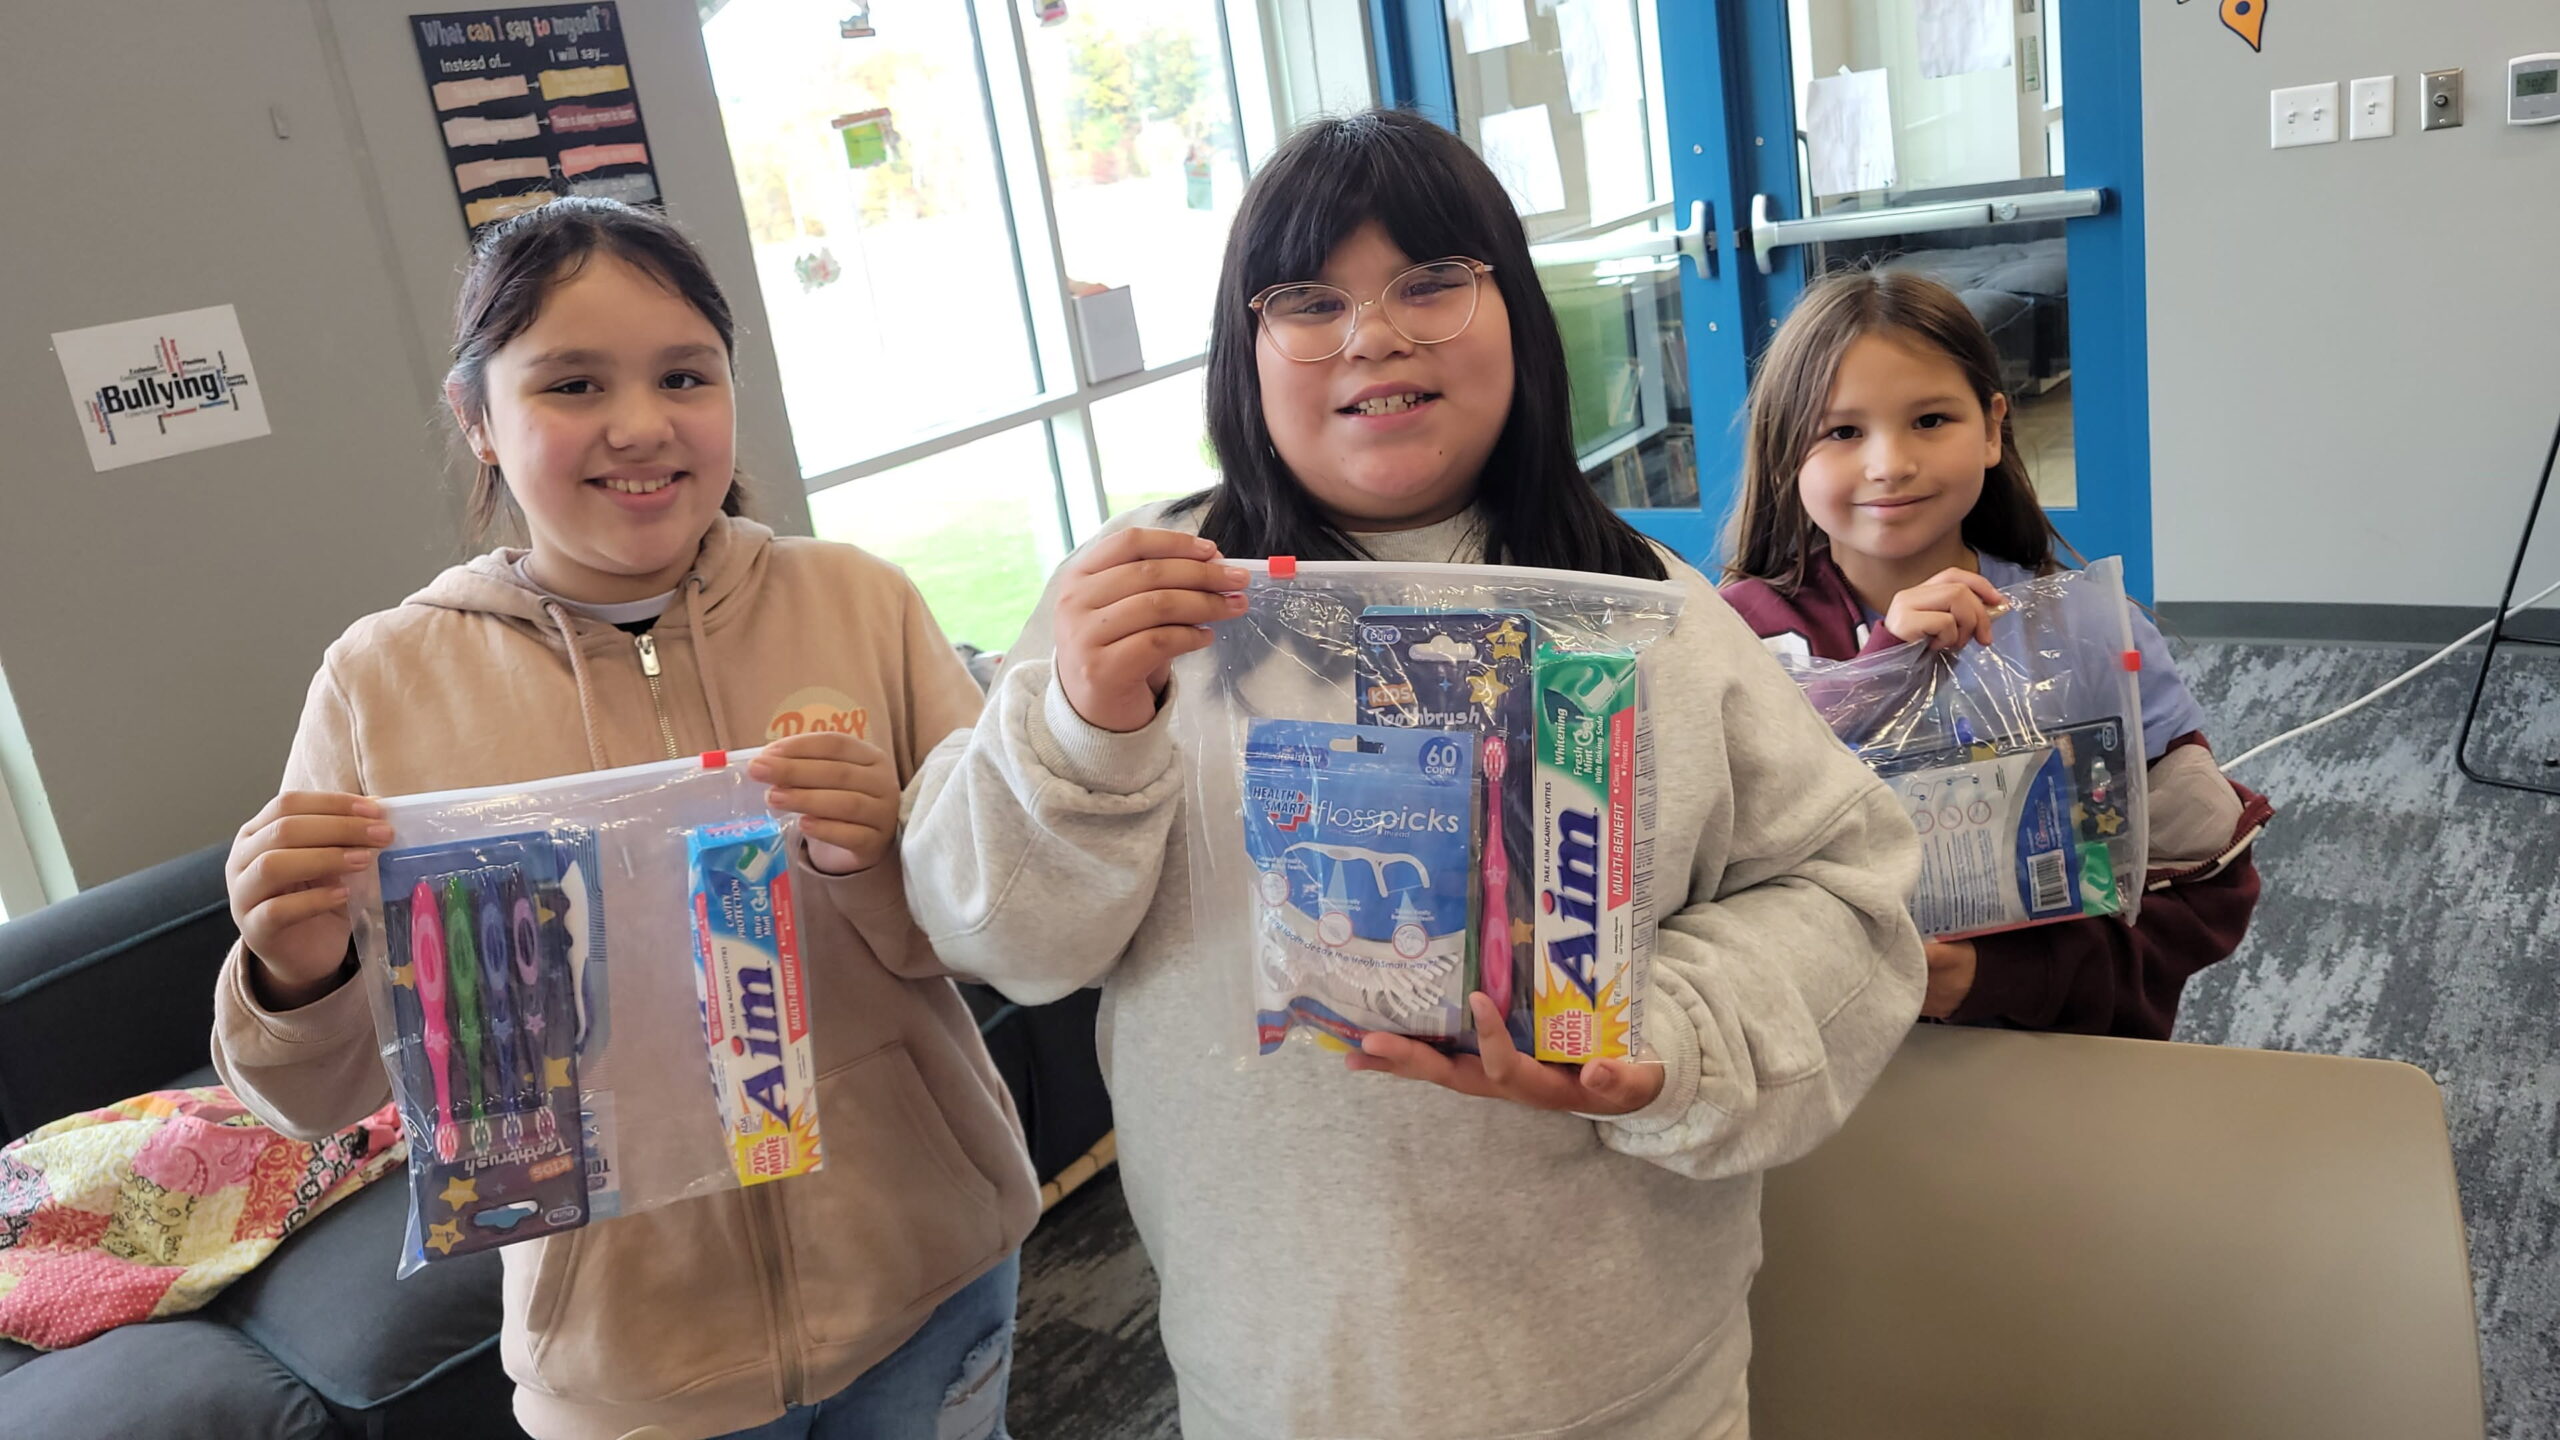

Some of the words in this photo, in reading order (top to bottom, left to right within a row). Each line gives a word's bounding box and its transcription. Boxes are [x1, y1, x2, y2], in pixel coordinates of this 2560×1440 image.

[420, 20, 466, 47] What
[467, 22, 496, 42] can
[493, 16, 505, 40] I
[506, 18, 535, 47] say
[533, 16, 550, 37] to
[440, 55, 486, 73] Instead
[549, 49, 556, 62] I
[557, 46, 579, 61] will
[101, 372, 220, 414] Bullying
[1370, 631, 1394, 642] Pure
[1496, 633, 1507, 647] 4
[1371, 688, 1411, 704] KIDS
[1368, 705, 1480, 728] Toothbrush
[1595, 716, 1604, 735] Soda
[1555, 708, 1568, 765] Whitening
[1573, 715, 1594, 746] Gel
[1426, 744, 1457, 768] 60
[1573, 747, 1583, 776] Fresh
[1583, 749, 1593, 774] Mint
[1595, 738, 1604, 764] Baking
[1424, 766, 1456, 776] COUNT
[1595, 766, 1603, 784] With
[1252, 785, 1297, 801] HEALTH
[1264, 800, 1306, 815] SMART
[1317, 800, 1460, 835] flosspicks
[1612, 802, 1625, 895] MULTI-BENEFIT
[722, 895, 735, 928] CAVITY
[731, 878, 746, 938] PROTECTION
[750, 886, 768, 912] Gel
[1542, 810, 1598, 1012] Aim
[754, 916, 764, 939] Ultra
[763, 916, 772, 936] Mint
[1550, 1015, 1565, 1051] 20%
[1566, 1010, 1582, 1056] MORE
[1583, 1014, 1592, 1053] Product
[731, 966, 791, 1132] Aim
[464, 1137, 572, 1176] Toothbrush
[754, 1141, 768, 1175] 20%
[767, 1135, 783, 1176] MORE
[782, 1137, 792, 1170] Product
[531, 1157, 571, 1178] KIDS
